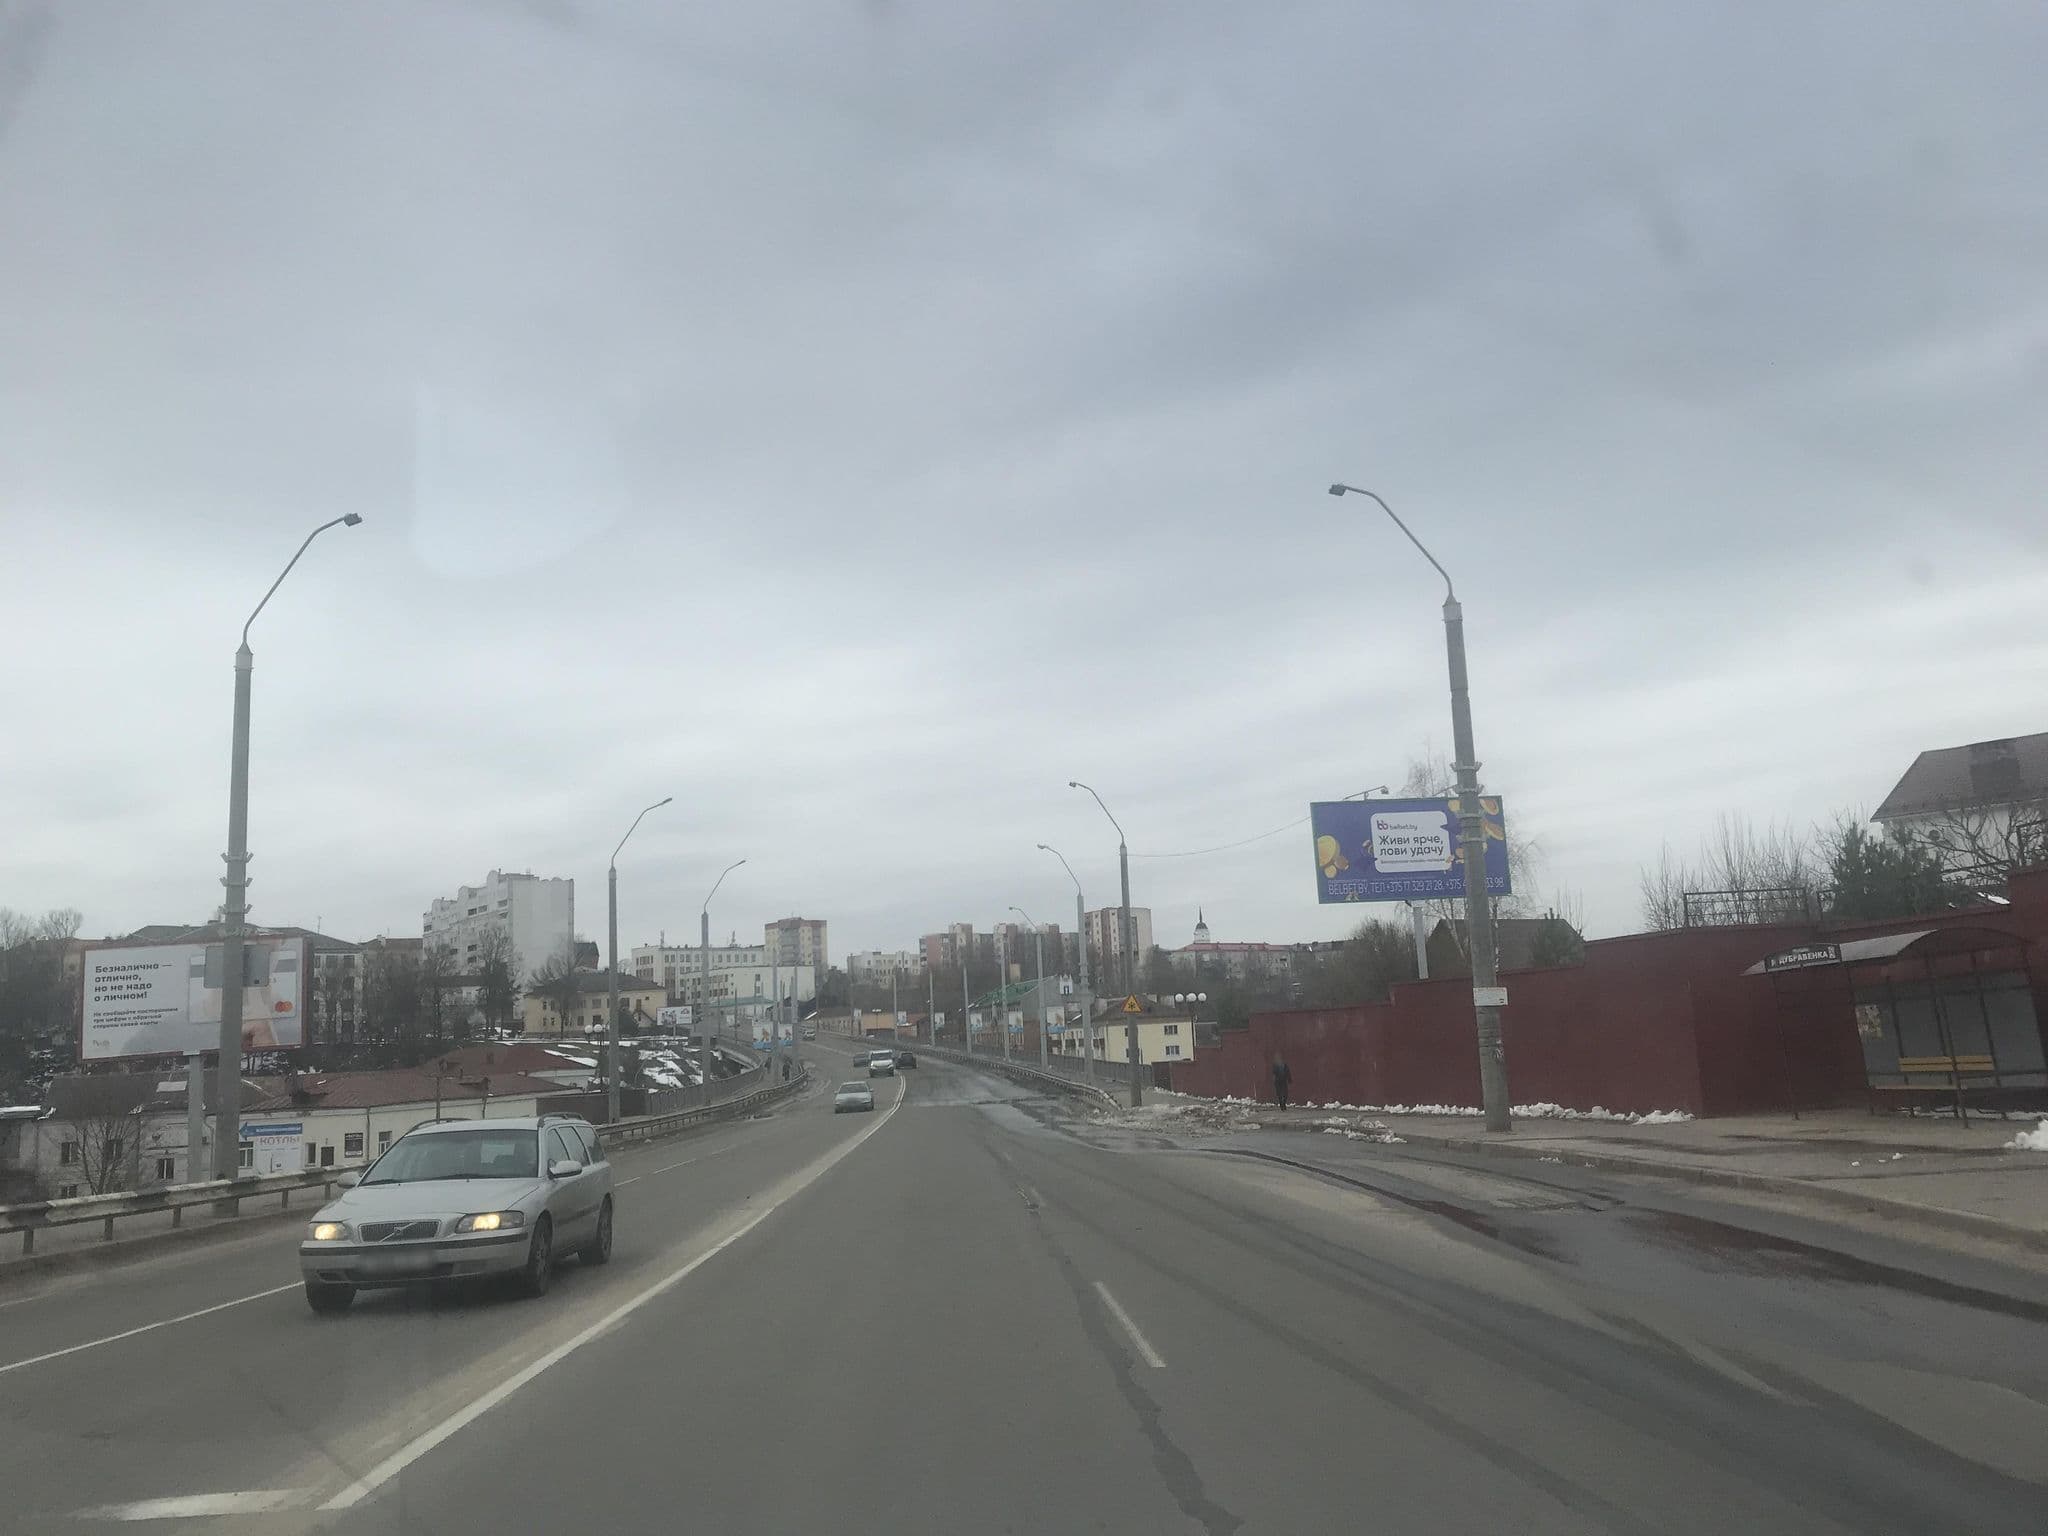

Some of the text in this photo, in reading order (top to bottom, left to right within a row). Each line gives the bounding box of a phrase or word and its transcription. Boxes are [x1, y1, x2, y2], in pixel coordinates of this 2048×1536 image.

[1379, 835, 1443, 846] Живи ярче,
[1380, 846, 1444, 857] лови удачу
[96, 964, 159, 973] Безналично
[95, 975, 142, 983] отлично,
[103, 992, 147, 1001] личном!
